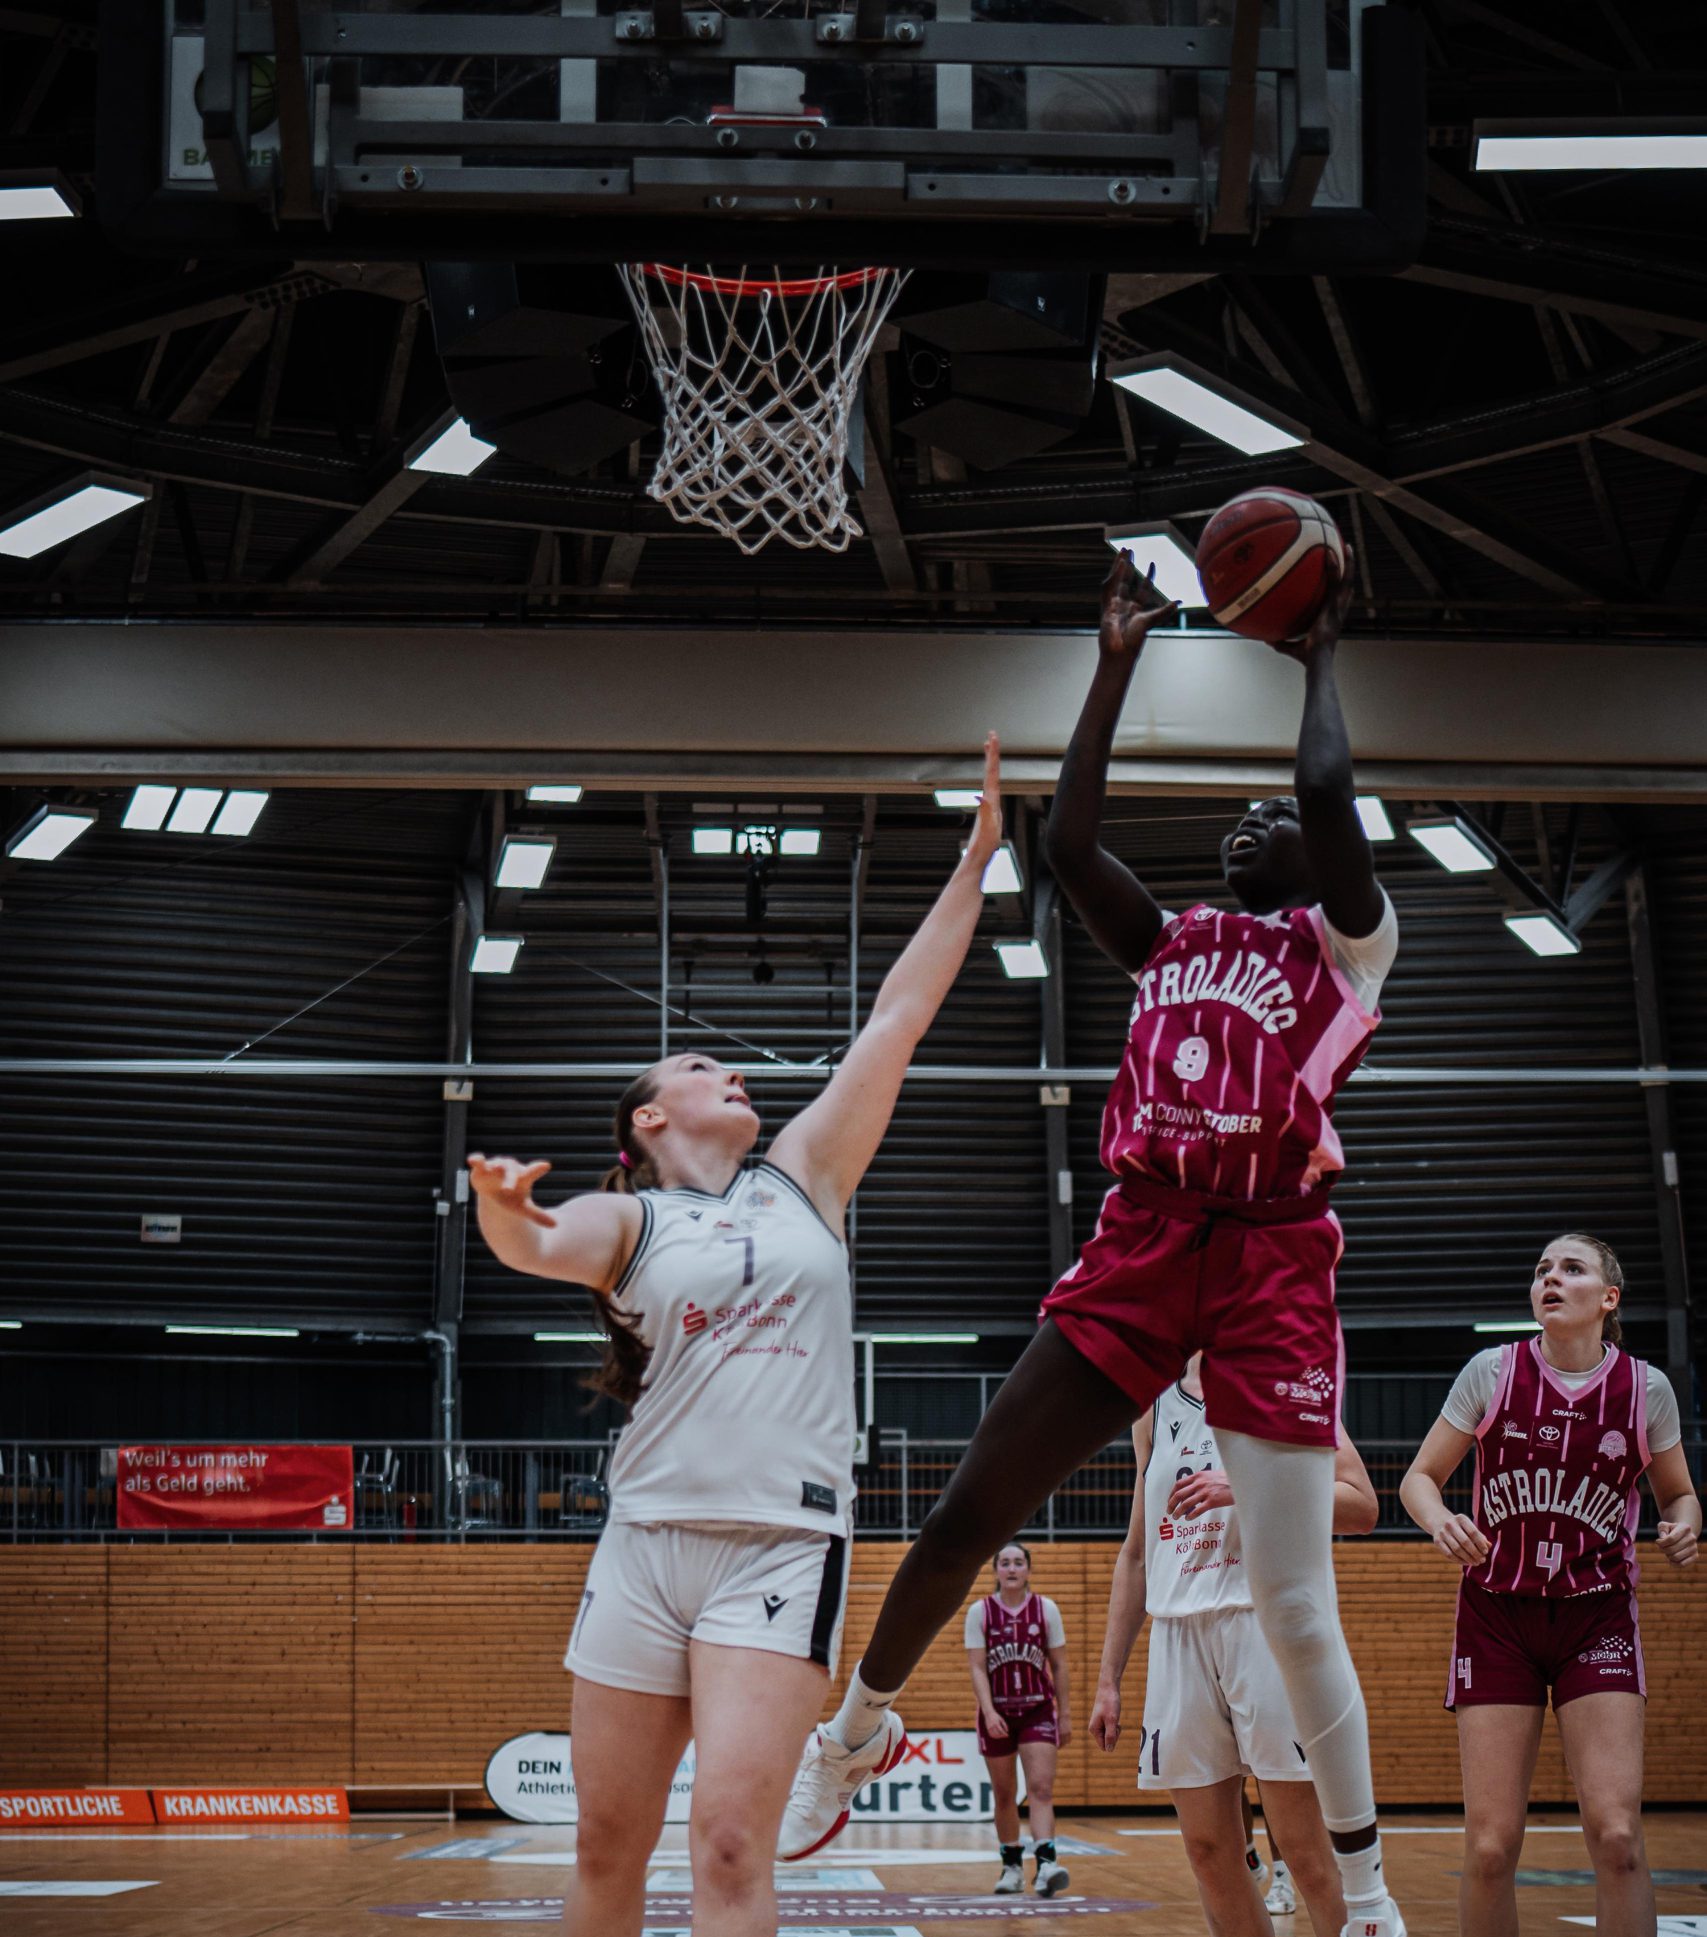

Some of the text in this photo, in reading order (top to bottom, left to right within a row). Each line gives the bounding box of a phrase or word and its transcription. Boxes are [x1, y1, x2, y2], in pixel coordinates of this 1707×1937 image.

[1173, 1036, 1210, 1082] 9
[724, 1236, 755, 1286] 7
[1552, 1409, 1580, 1419] CRAFT
[125, 1450, 268, 1468] Weil's um mehr
[125, 1473, 251, 1494] als Geld geht.
[1483, 1468, 1626, 1544] ASTROLADIES
[1536, 1541, 1563, 1582] 4
[1013, 1671, 1022, 1689] 1
[1457, 1657, 1471, 1689] 4
[518, 1760, 561, 1774] DEIN
[0, 1795, 339, 1817] SPORTLICHE KRANKENKASSE
